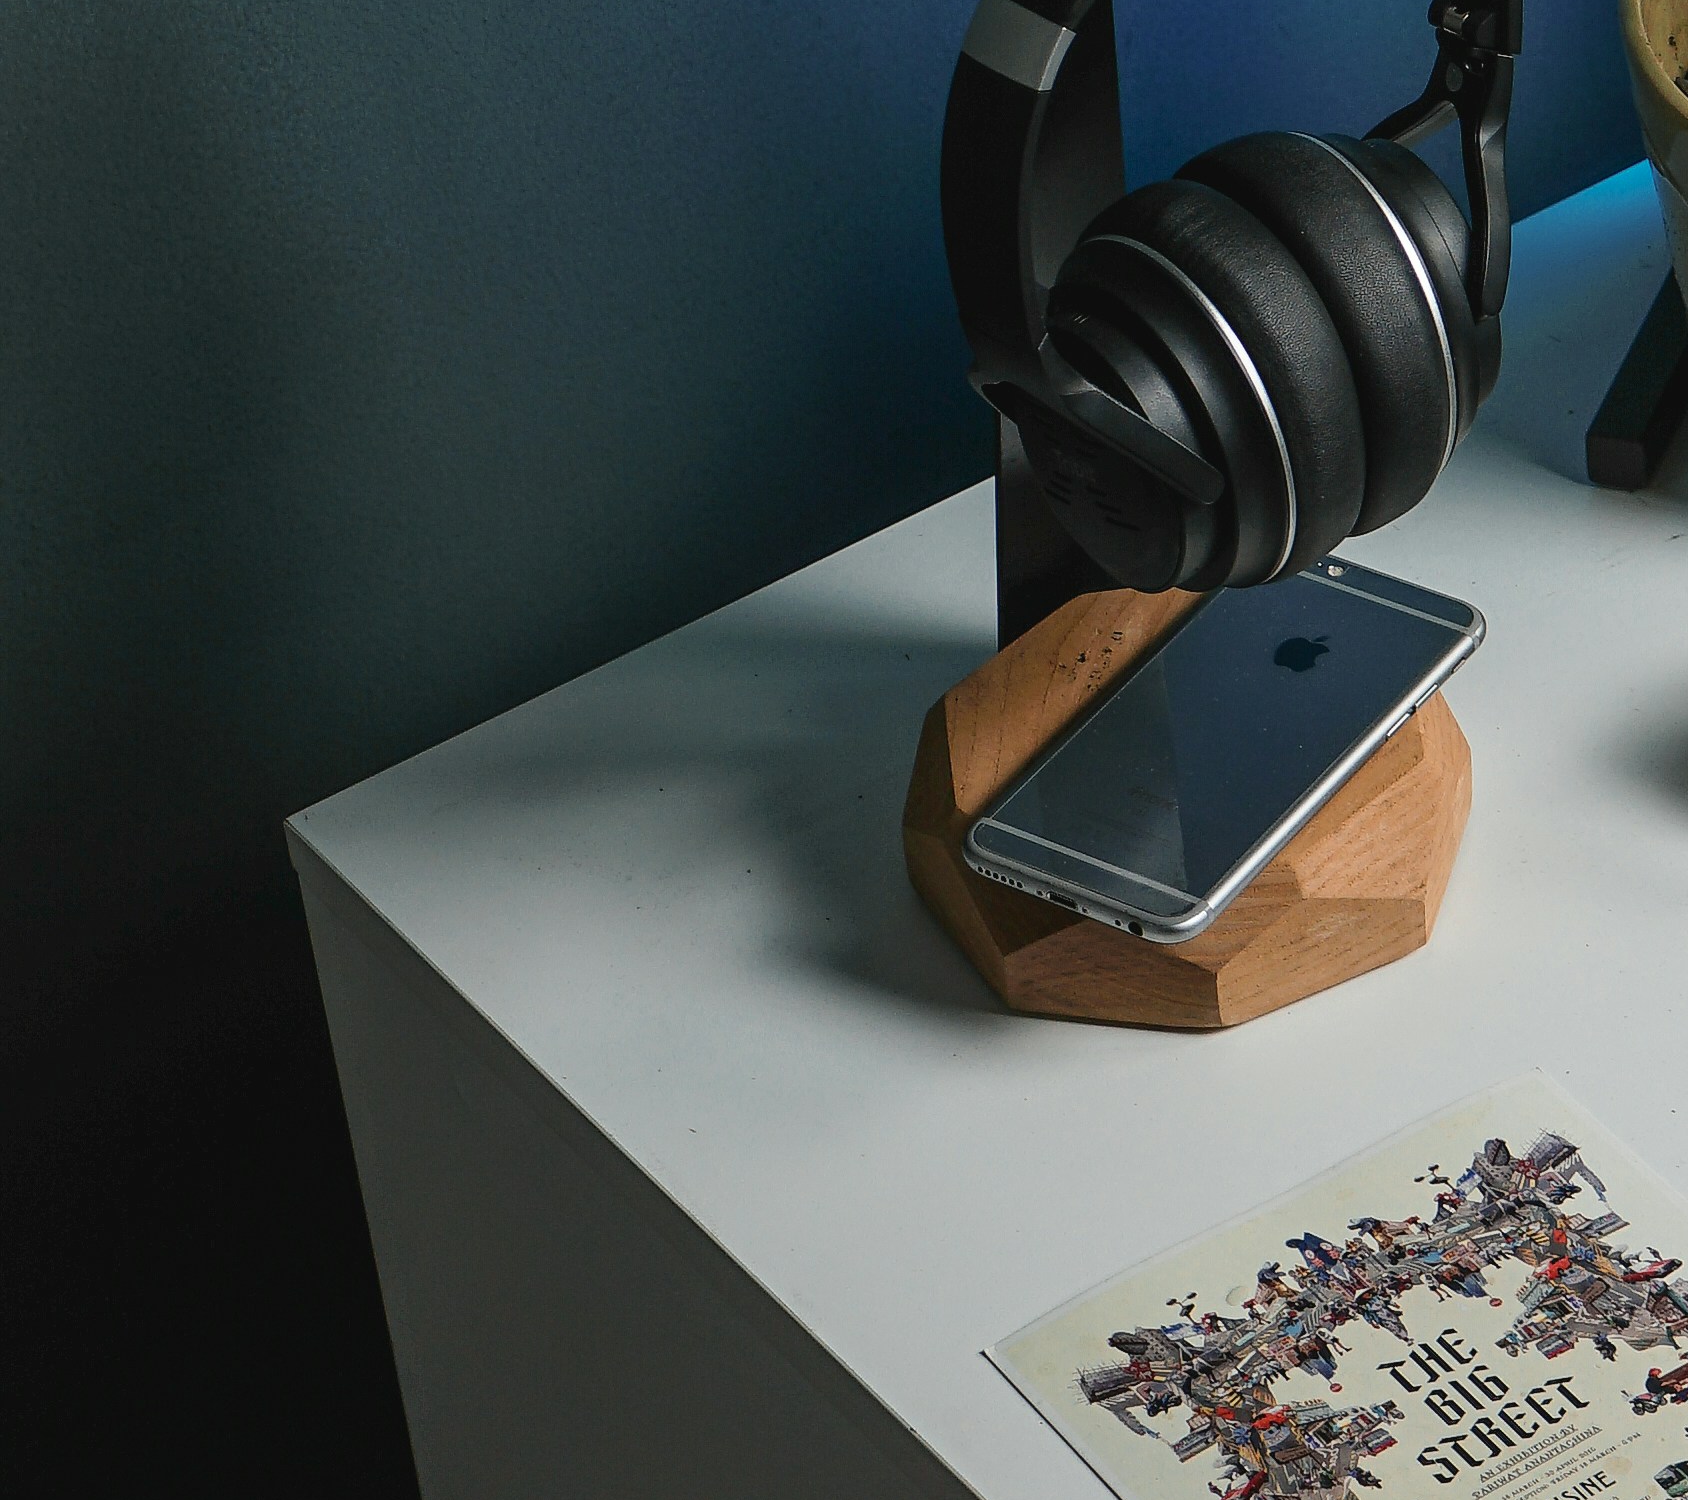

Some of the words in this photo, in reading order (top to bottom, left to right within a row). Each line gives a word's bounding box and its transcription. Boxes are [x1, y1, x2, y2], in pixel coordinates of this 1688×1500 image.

[1376, 1327, 1480, 1393] THE
[1424, 1364, 1511, 1426] BIG
[1416, 1376, 1590, 1484] STREET
[1480, 1468, 1495, 1483] AN
[1495, 1433, 1560, 1474] EXHIBITION
[1559, 1423, 1579, 1441] BY
[1471, 1467, 1523, 1500] PARIWAT
